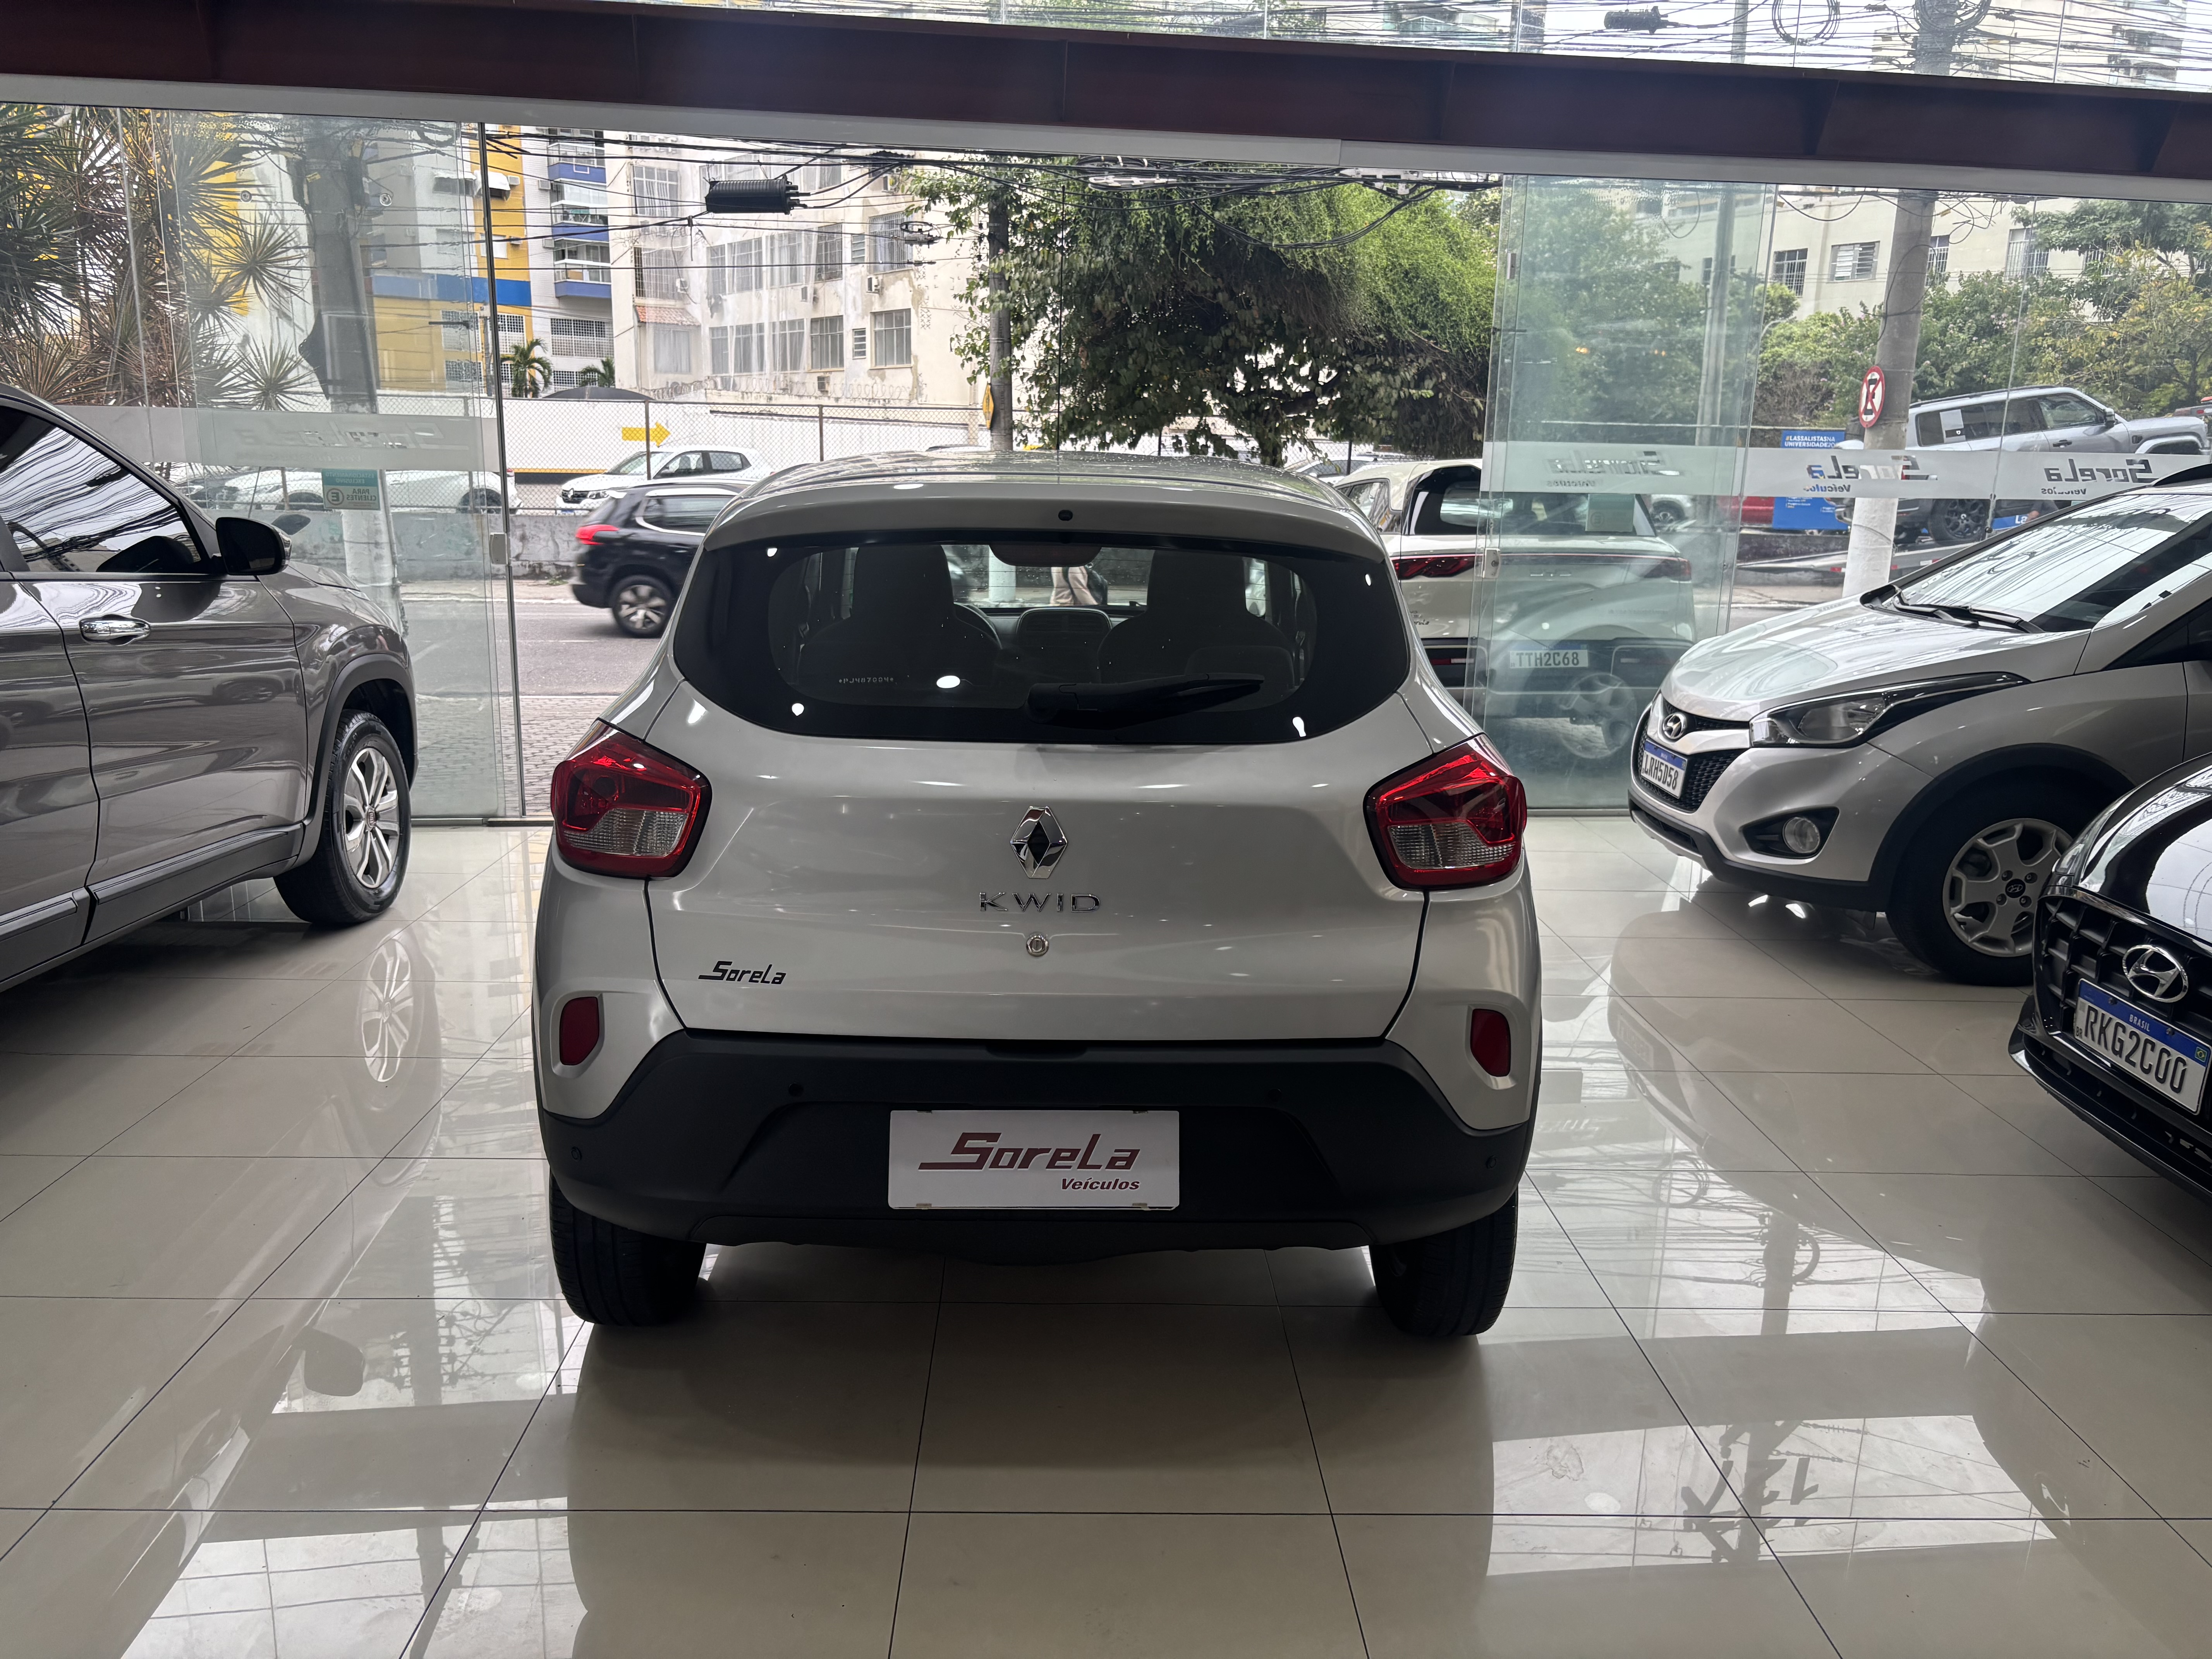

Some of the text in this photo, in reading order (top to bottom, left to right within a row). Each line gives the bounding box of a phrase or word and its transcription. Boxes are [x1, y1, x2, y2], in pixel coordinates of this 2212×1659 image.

[1516, 652, 1579, 667] TTH2C68
[1644, 754, 1679, 791] LRH5D58
[979, 892, 1101, 912] KWID
[2129, 1013, 2150, 1032] BRASIL
[2076, 1026, 2083, 1039] BR
[2085, 1005, 2188, 1094] RKG2C00
[1061, 1177, 1140, 1190] Veículos
